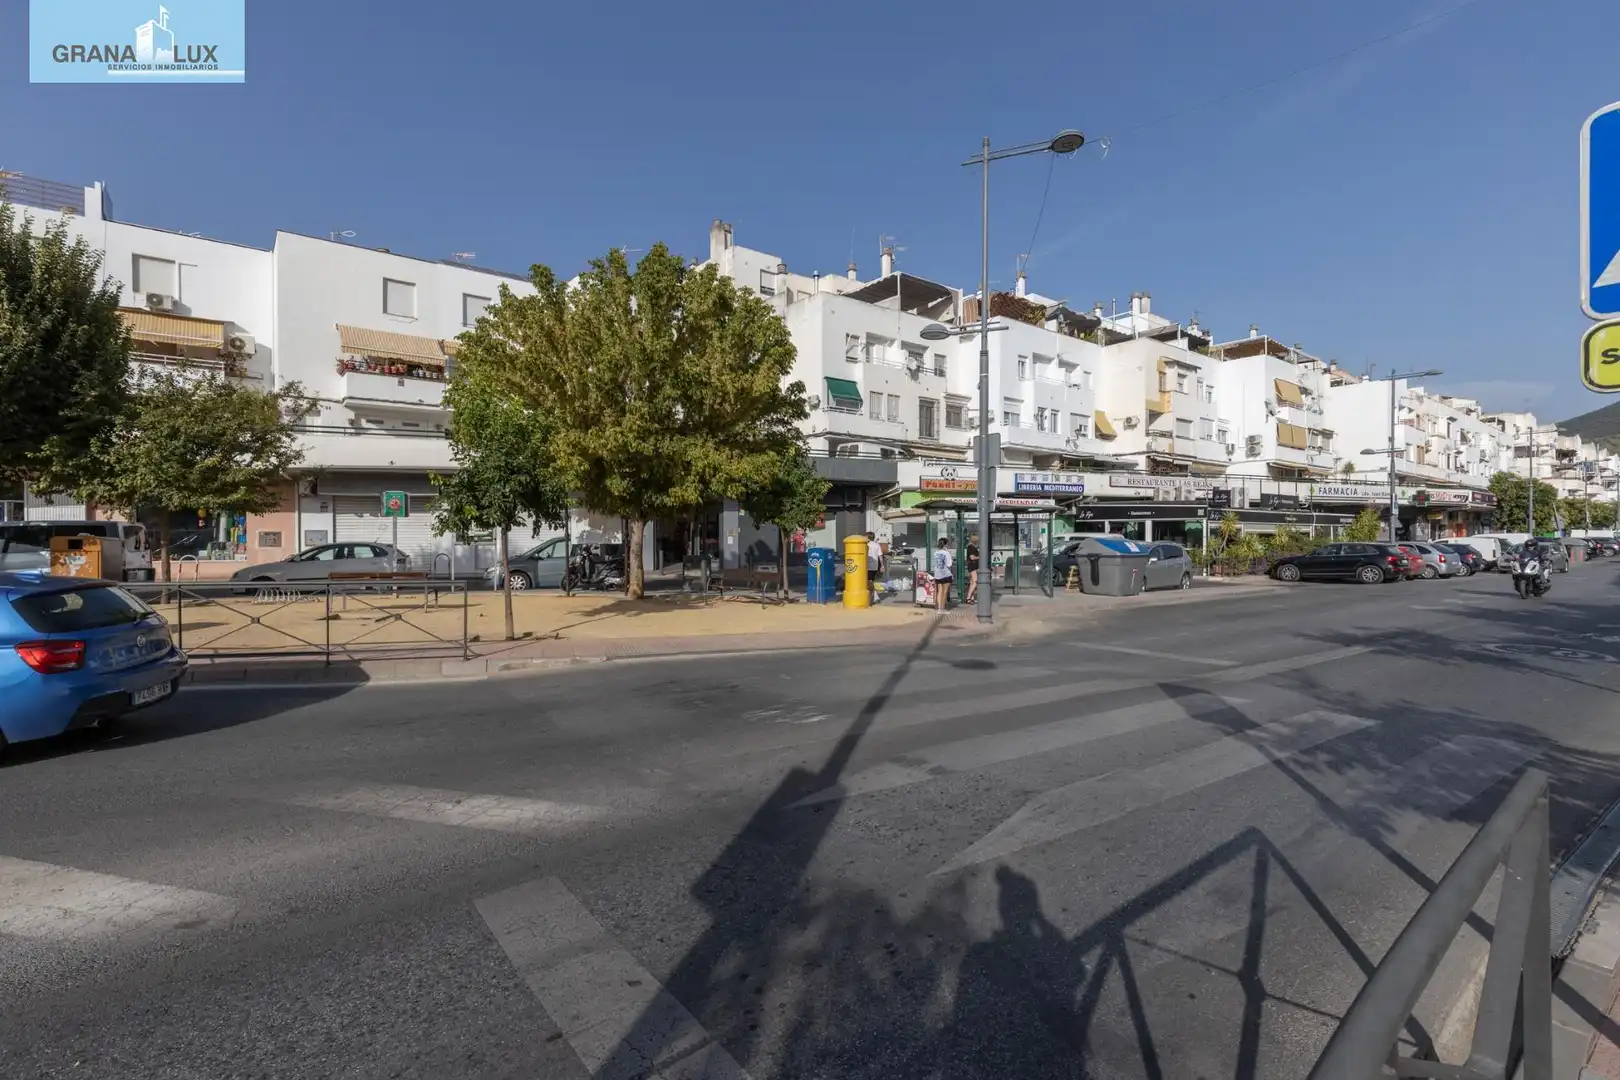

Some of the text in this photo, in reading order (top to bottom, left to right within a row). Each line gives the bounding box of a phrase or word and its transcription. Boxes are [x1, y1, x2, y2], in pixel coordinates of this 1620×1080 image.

[1018, 483, 1042, 491] LIBRERIA
[1127, 478, 1176, 487] RESTAURANTE
[1318, 486, 1358, 496] FARMACIA
